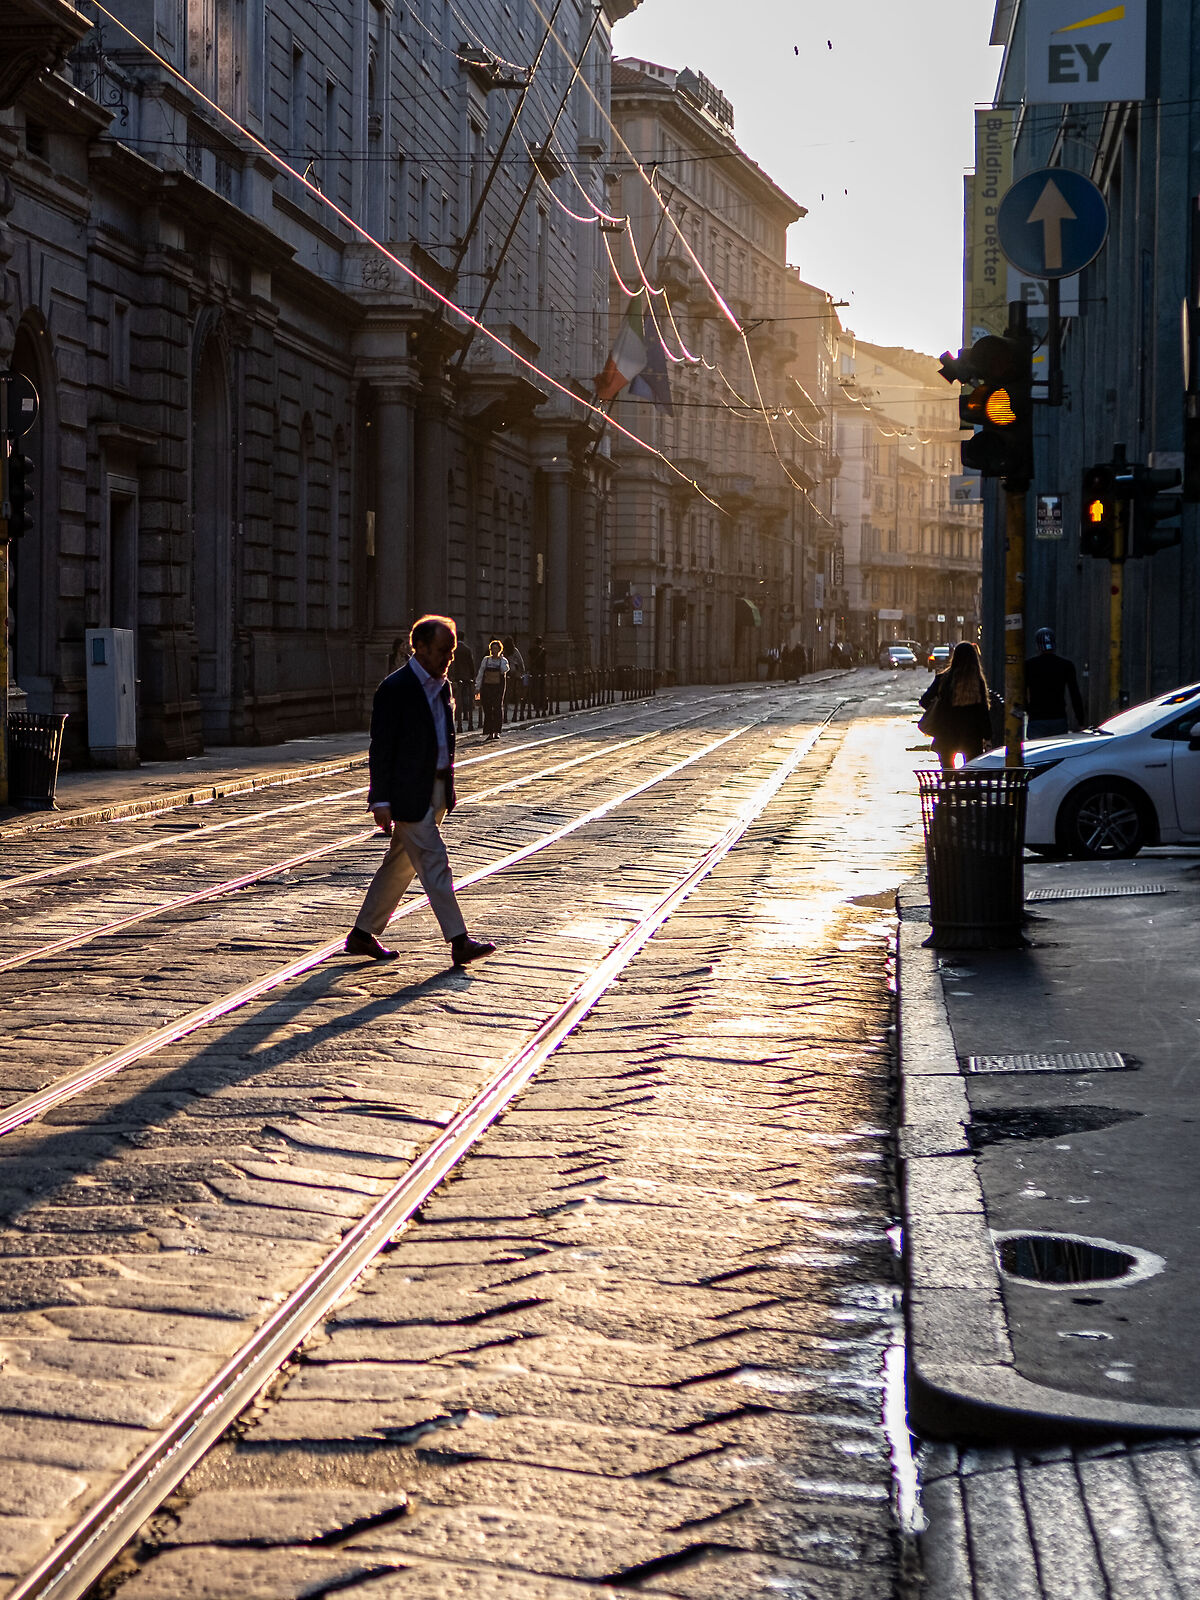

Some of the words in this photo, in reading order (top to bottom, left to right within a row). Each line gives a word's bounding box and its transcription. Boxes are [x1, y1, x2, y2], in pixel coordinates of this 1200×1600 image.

[1048, 43, 1112, 84] EY
[981, 117, 1003, 200] Building
[984, 206, 998, 218] a
[955, 489, 971, 499] EY
[1041, 496, 1058, 517] T
